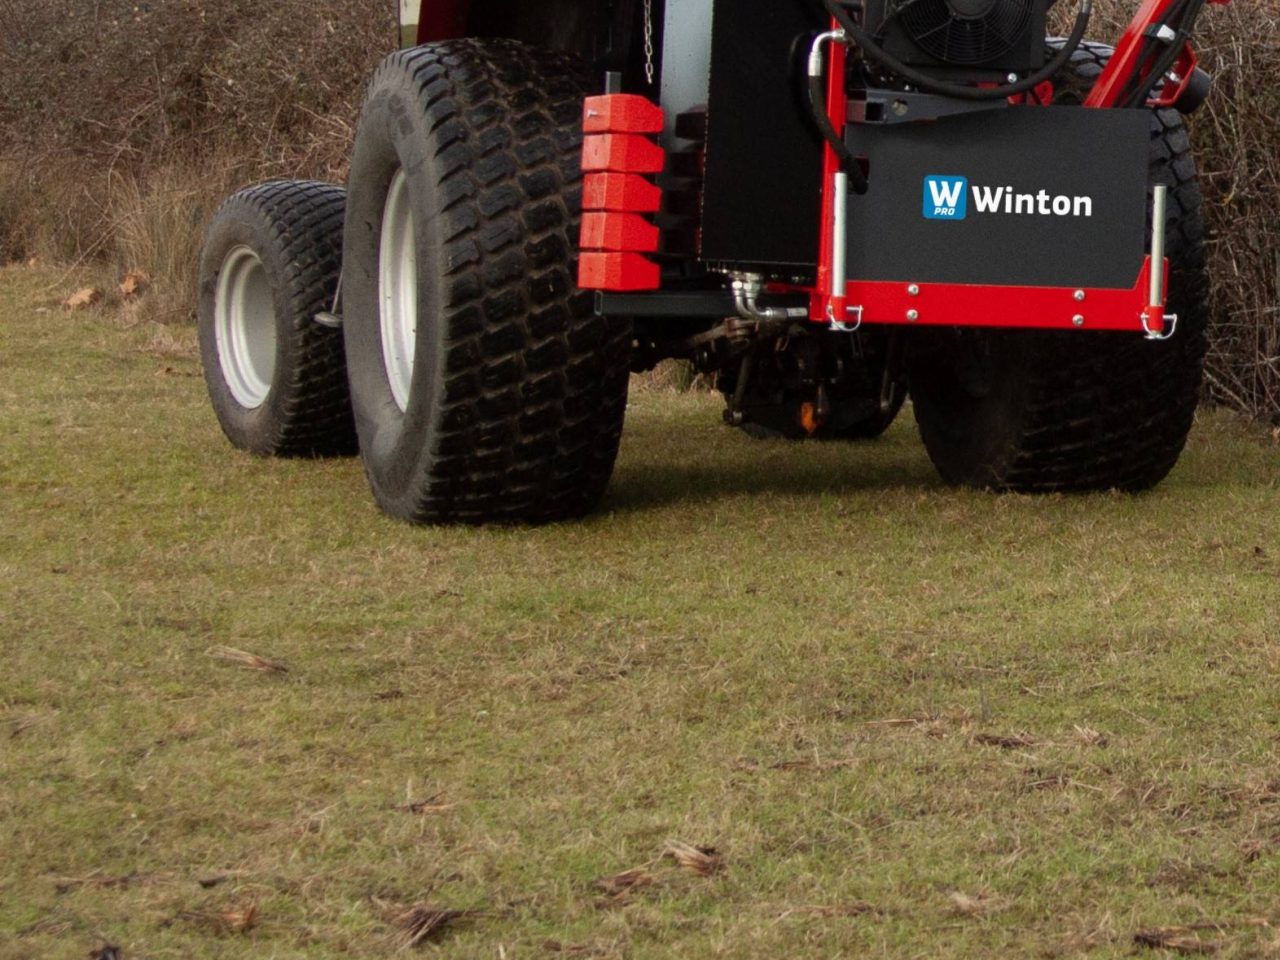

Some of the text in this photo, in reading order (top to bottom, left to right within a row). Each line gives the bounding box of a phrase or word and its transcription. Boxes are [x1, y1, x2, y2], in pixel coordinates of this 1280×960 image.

[928, 180, 963, 207] W
[971, 185, 1093, 217] Winton
[934, 207, 956, 216] PRO
